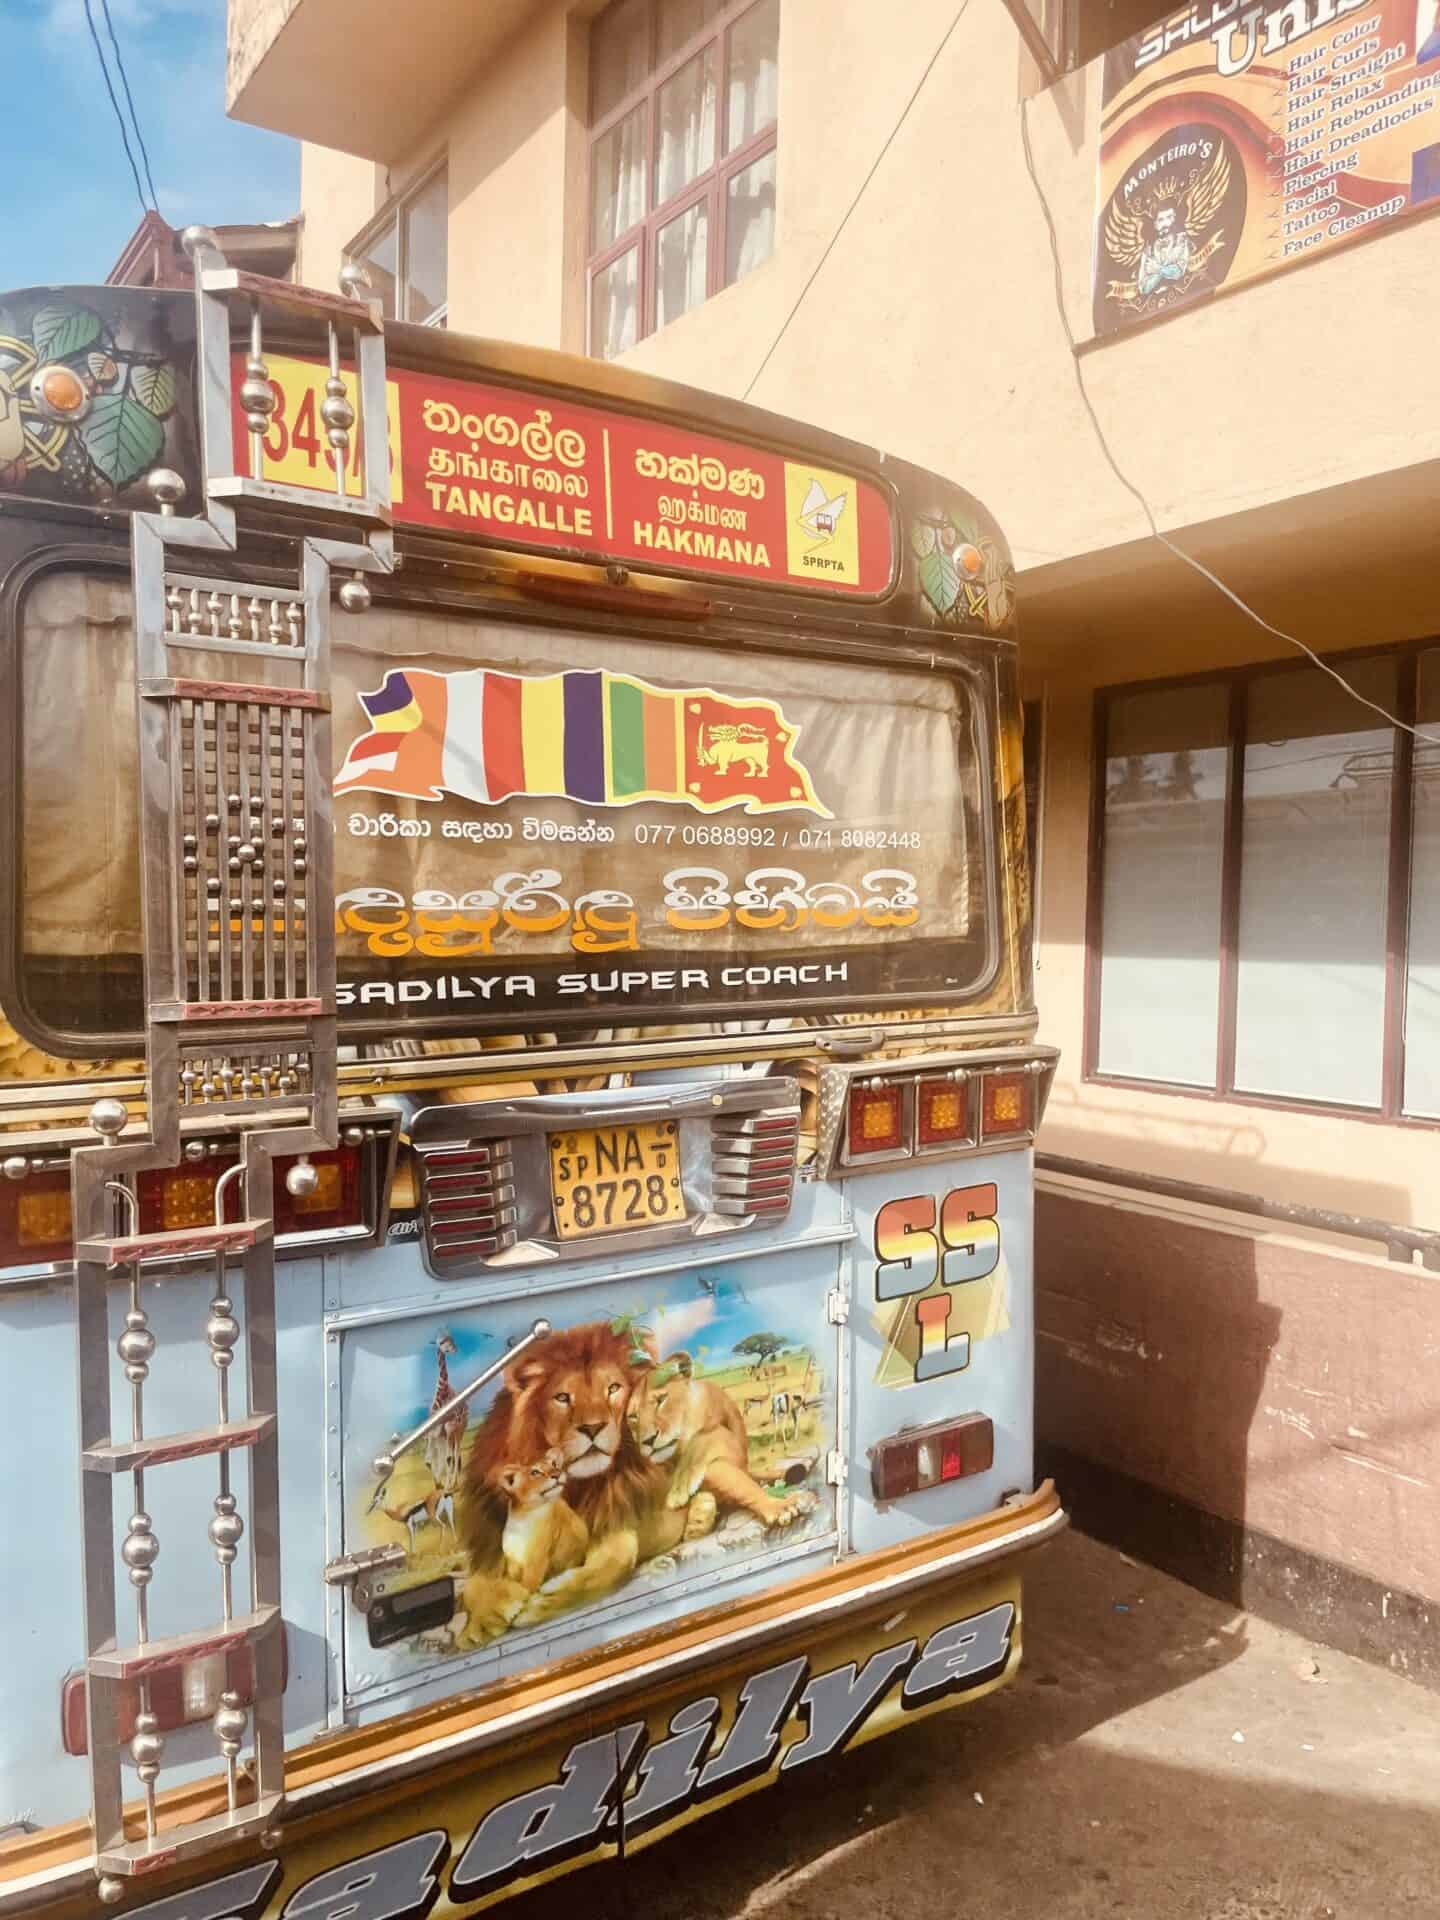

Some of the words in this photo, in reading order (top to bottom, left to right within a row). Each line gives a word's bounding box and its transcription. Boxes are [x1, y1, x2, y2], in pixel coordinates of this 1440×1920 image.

[1288, 67, 1326, 92] Hair
[1331, 39, 1378, 71] Curls
[1289, 46, 1326, 72] Hair
[1332, 17, 1380, 50] Color
[1287, 108, 1325, 133] Hair
[1330, 79, 1383, 113] Relax
[1288, 87, 1325, 113] Hair
[1330, 46, 1404, 91] Straight
[1285, 149, 1323, 174] Hair
[1329, 98, 1434, 154] Dreadlocks
[1286, 128, 1324, 154] Hair
[1329, 75, 1440, 133] Rebounding
[1284, 152, 1358, 195] Piercing
[1284, 181, 1336, 215] Facial
[1283, 204, 1339, 235] Tattoo
[1283, 232, 1322, 256] Face
[1328, 196, 1405, 237] Cleanup
[422, 399, 586, 468] තංගල්ල
[425, 441, 589, 498] தங்காலை
[425, 481, 593, 537] TANGALLE
[658, 489, 747, 532] ஹக்மண
[633, 520, 771, 568] HAKMANA
[802, 555, 845, 572] SPRPTA
[347, 813, 431, 838] චාරිකා
[441, 818, 512, 844] සඳහා
[634, 824, 673, 844] 077
[682, 826, 776, 847] 0688992
[799, 830, 832, 847] 071
[841, 831, 921, 849] 8082448
[335, 975, 536, 1006] SADILYA
[557, 969, 709, 996] SUPER
[721, 961, 849, 988] COACH
[559, 1155, 588, 1181] SP
[572, 1175, 669, 1229] 8728
[874, 1181, 1001, 1302] SS
